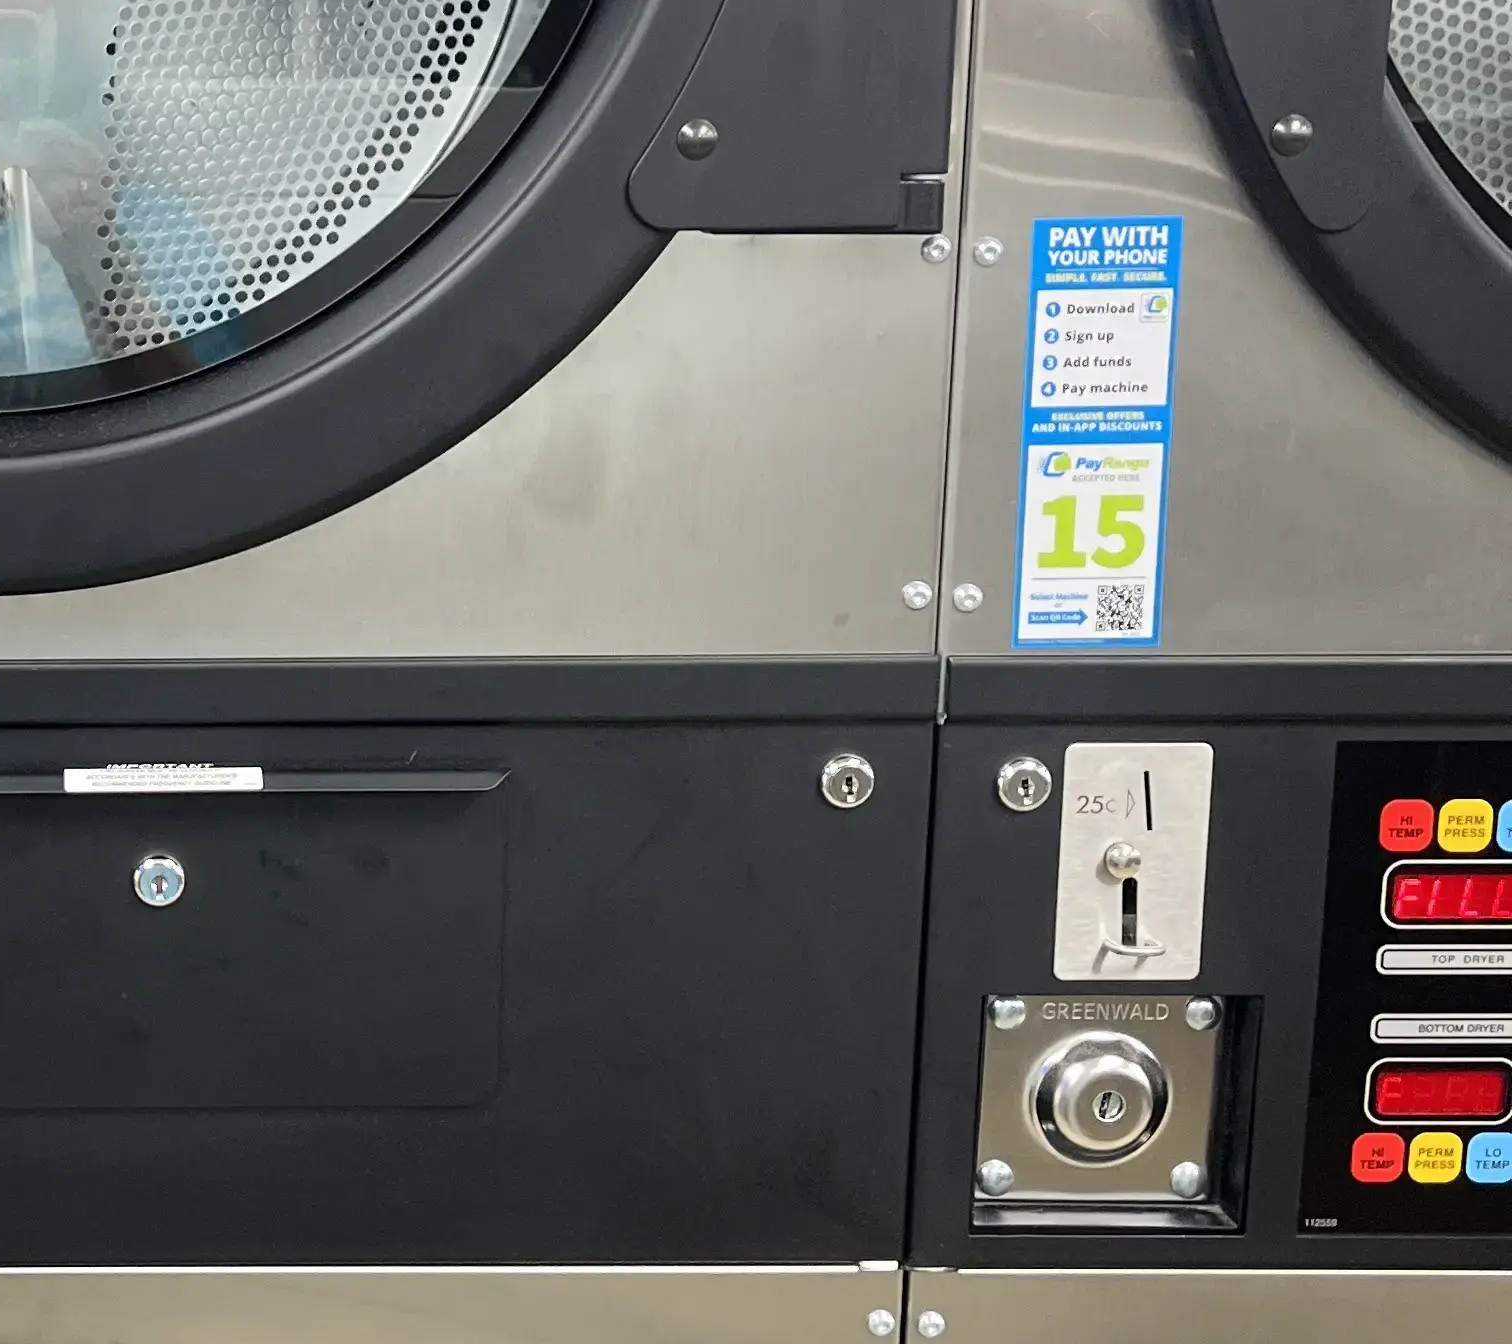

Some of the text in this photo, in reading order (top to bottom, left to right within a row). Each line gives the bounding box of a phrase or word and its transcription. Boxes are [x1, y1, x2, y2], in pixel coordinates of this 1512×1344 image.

[1049, 225, 1169, 247] PAY WITH
[1048, 248, 1168, 266] YOUR PHONE
[1066, 302, 1135, 314] Download
[1064, 330, 1093, 344] Sign
[1097, 331, 1115, 343] up
[1063, 357, 1089, 368] Add
[1093, 356, 1132, 368] funds
[1062, 383, 1086, 396] Pay
[1090, 381, 1149, 394] machine
[1106, 411, 1145, 420] OFFERS
[1032, 421, 1163, 433] AND IN-APP DISCOUNTS
[1076, 457, 1149, 472] PayRange
[1071, 473, 1140, 483] ACCEPTED HERE
[1037, 495, 1145, 569] 15
[1400, 816, 1413, 825] HI
[1447, 815, 1485, 825] PERM
[1388, 828, 1425, 838] TEMP
[1444, 828, 1485, 838] PRESS
[1431, 955, 1505, 964] TOP DRYER
[1041, 1001, 1170, 1022] GREENWALD
[1418, 1024, 1505, 1033] BOTTOM DRYER
[1371, 1148, 1385, 1158] HI
[1418, 1147, 1454, 1157] PERM
[1485, 1148, 1502, 1158] LO
[1360, 1159, 1394, 1170] TEMP
[1414, 1160, 1455, 1169] PRESS
[1475, 1160, 1510, 1169] TEMP
